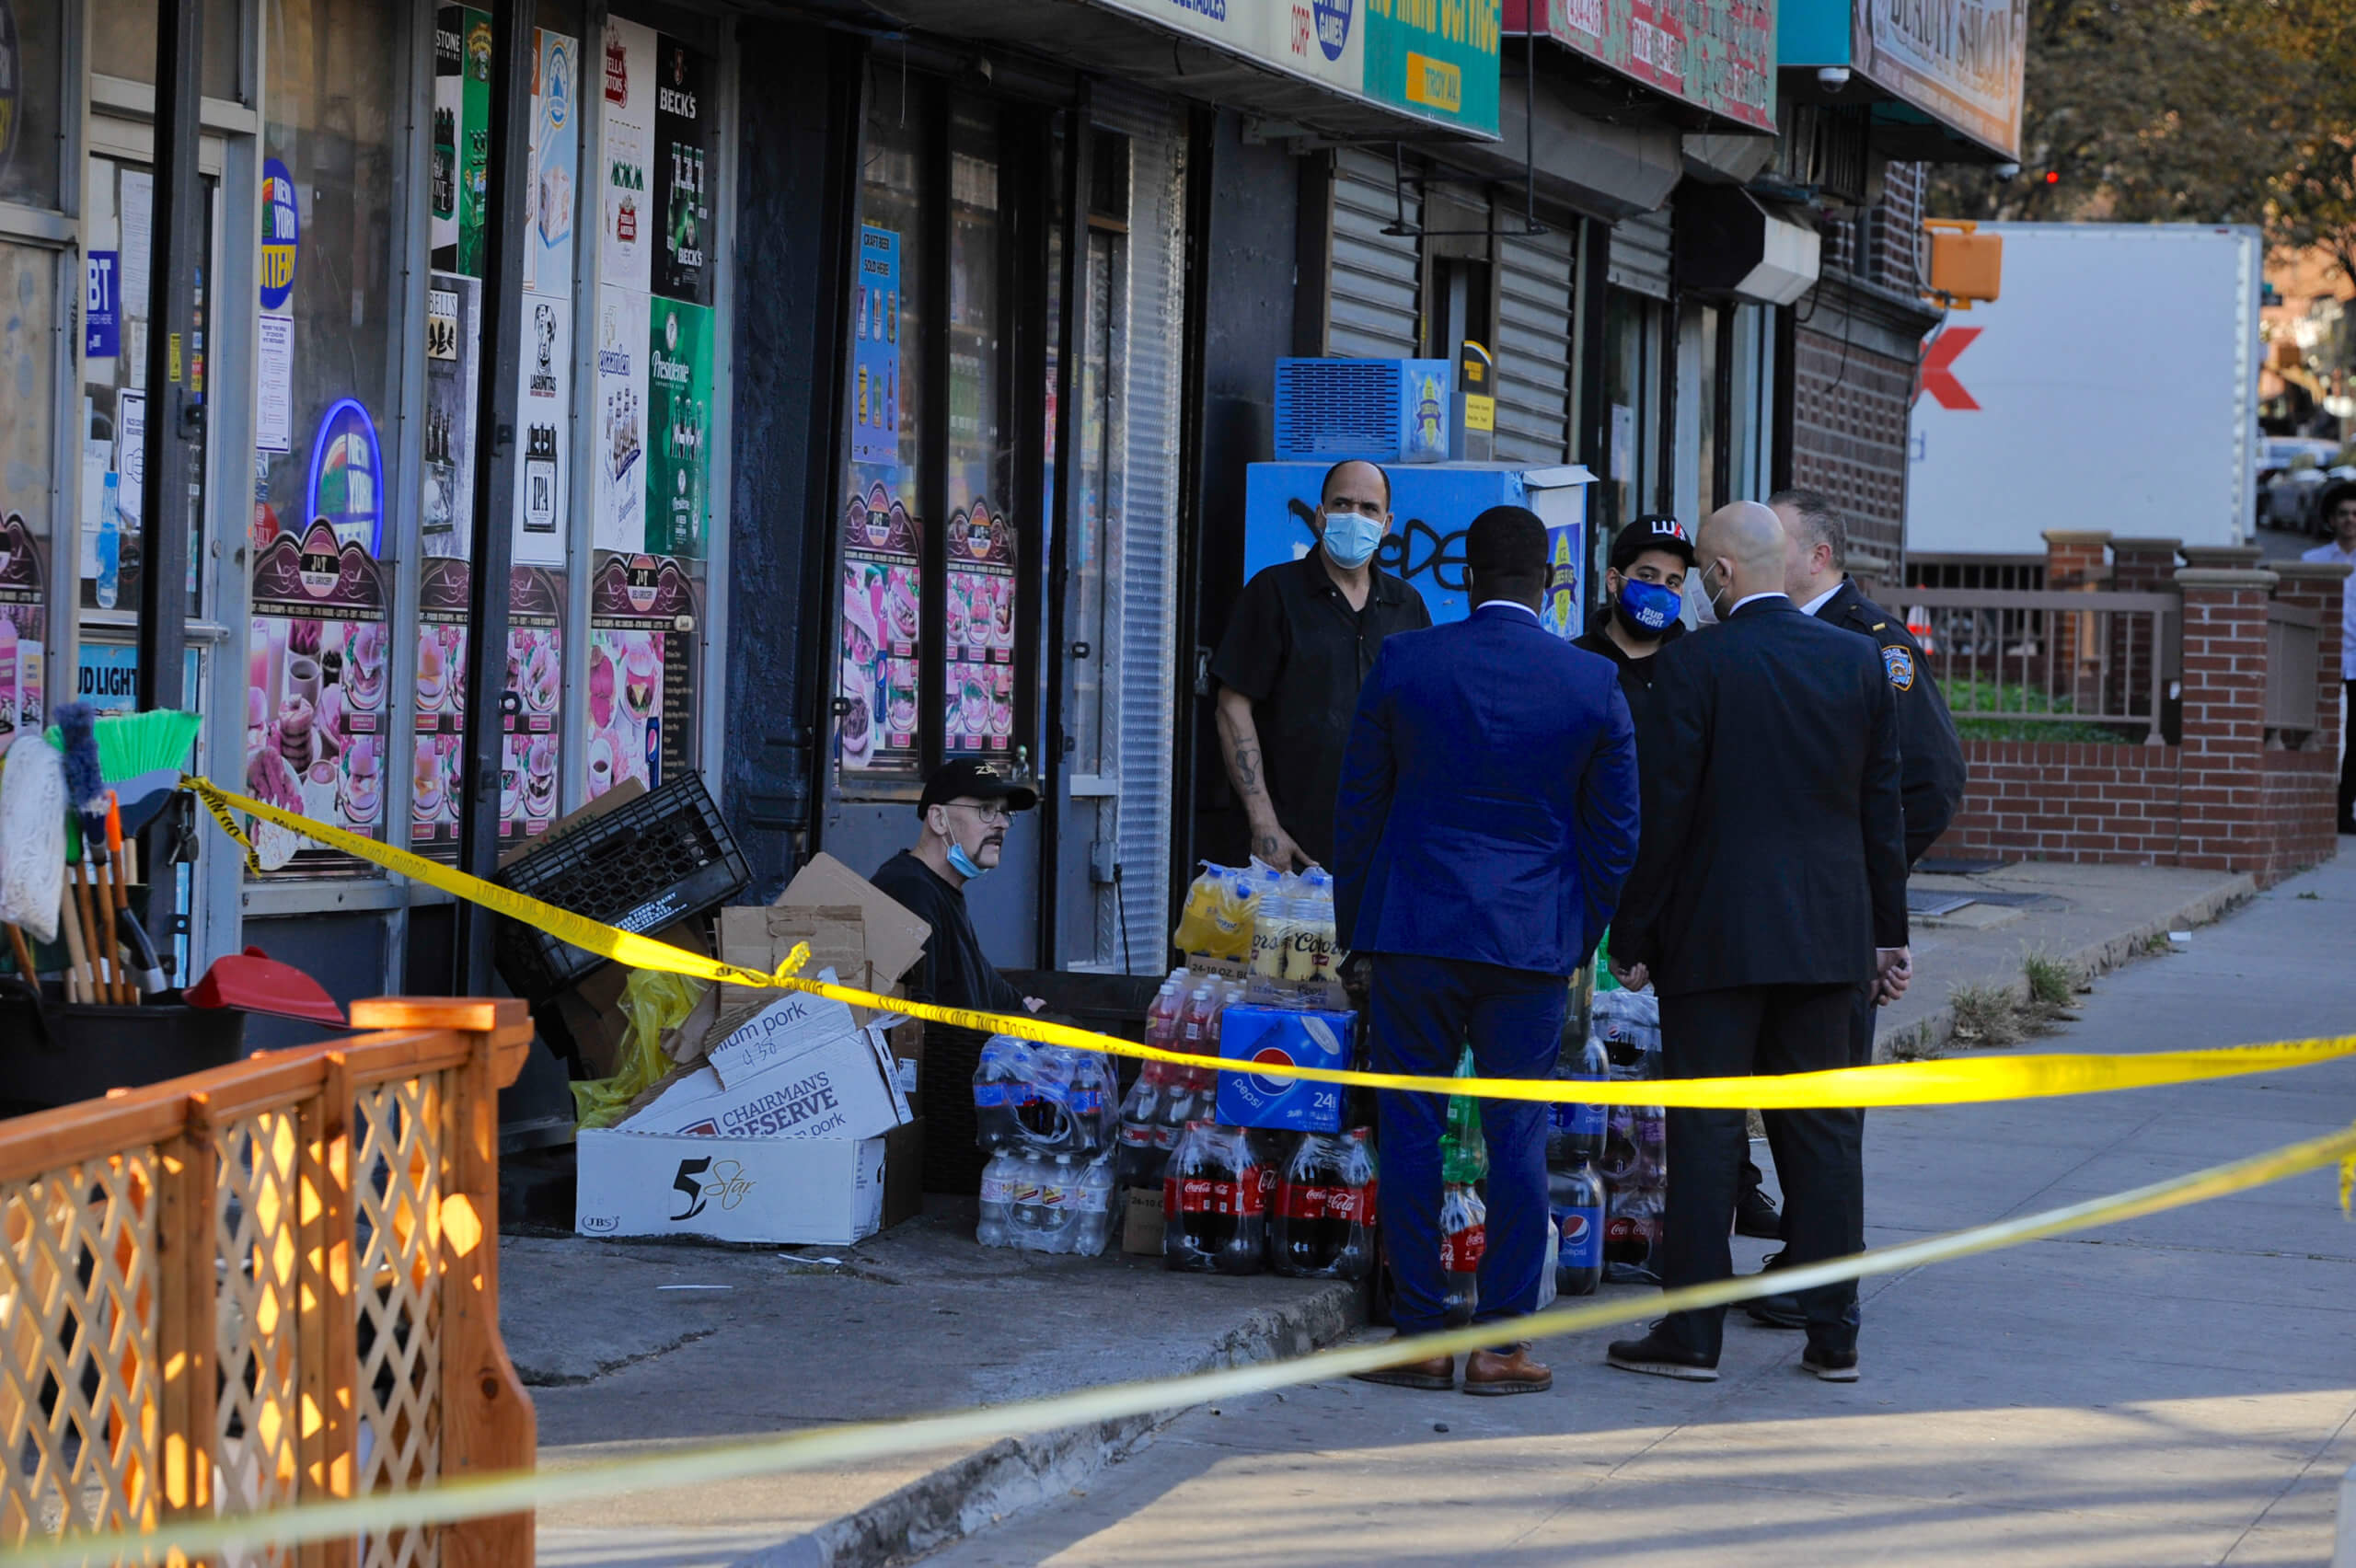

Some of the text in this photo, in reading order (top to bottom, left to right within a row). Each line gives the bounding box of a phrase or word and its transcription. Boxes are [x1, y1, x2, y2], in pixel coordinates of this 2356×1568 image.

[436, 29, 461, 52] STONE
[1291, 4, 1311, 57] CORP
[1319, 11, 1344, 48] GAMES
[607, 56, 624, 75] TELLA
[660, 86, 697, 120] BECK'S
[273, 176, 292, 206] NEW
[274, 204, 295, 239] YORK
[677, 245, 703, 267] BECK'S
[863, 233, 890, 250] CRAFT BEER
[260, 245, 296, 289] TTERY
[863, 259, 889, 277] SOLD HERE
[87, 259, 111, 311] BT
[652, 350, 689, 383] Presidente
[529, 375, 557, 390] LAGUNITAS
[532, 476, 549, 513] IPA
[1635, 611, 1665, 628] LIGHT
[1643, 606, 1664, 620] BUD
[77, 666, 137, 697] UD LIGHT
[1253, 933, 1277, 951] ors
[762, 1001, 808, 1037] pork
[722, 1071, 829, 1127] CHAIRMAN'S
[1231, 1078, 1265, 1109] pepsi
[1313, 1091, 1333, 1109] 24
[811, 1112, 846, 1136] pork
[670, 1155, 757, 1221] 5 Star
[587, 1216, 612, 1227] JBS
